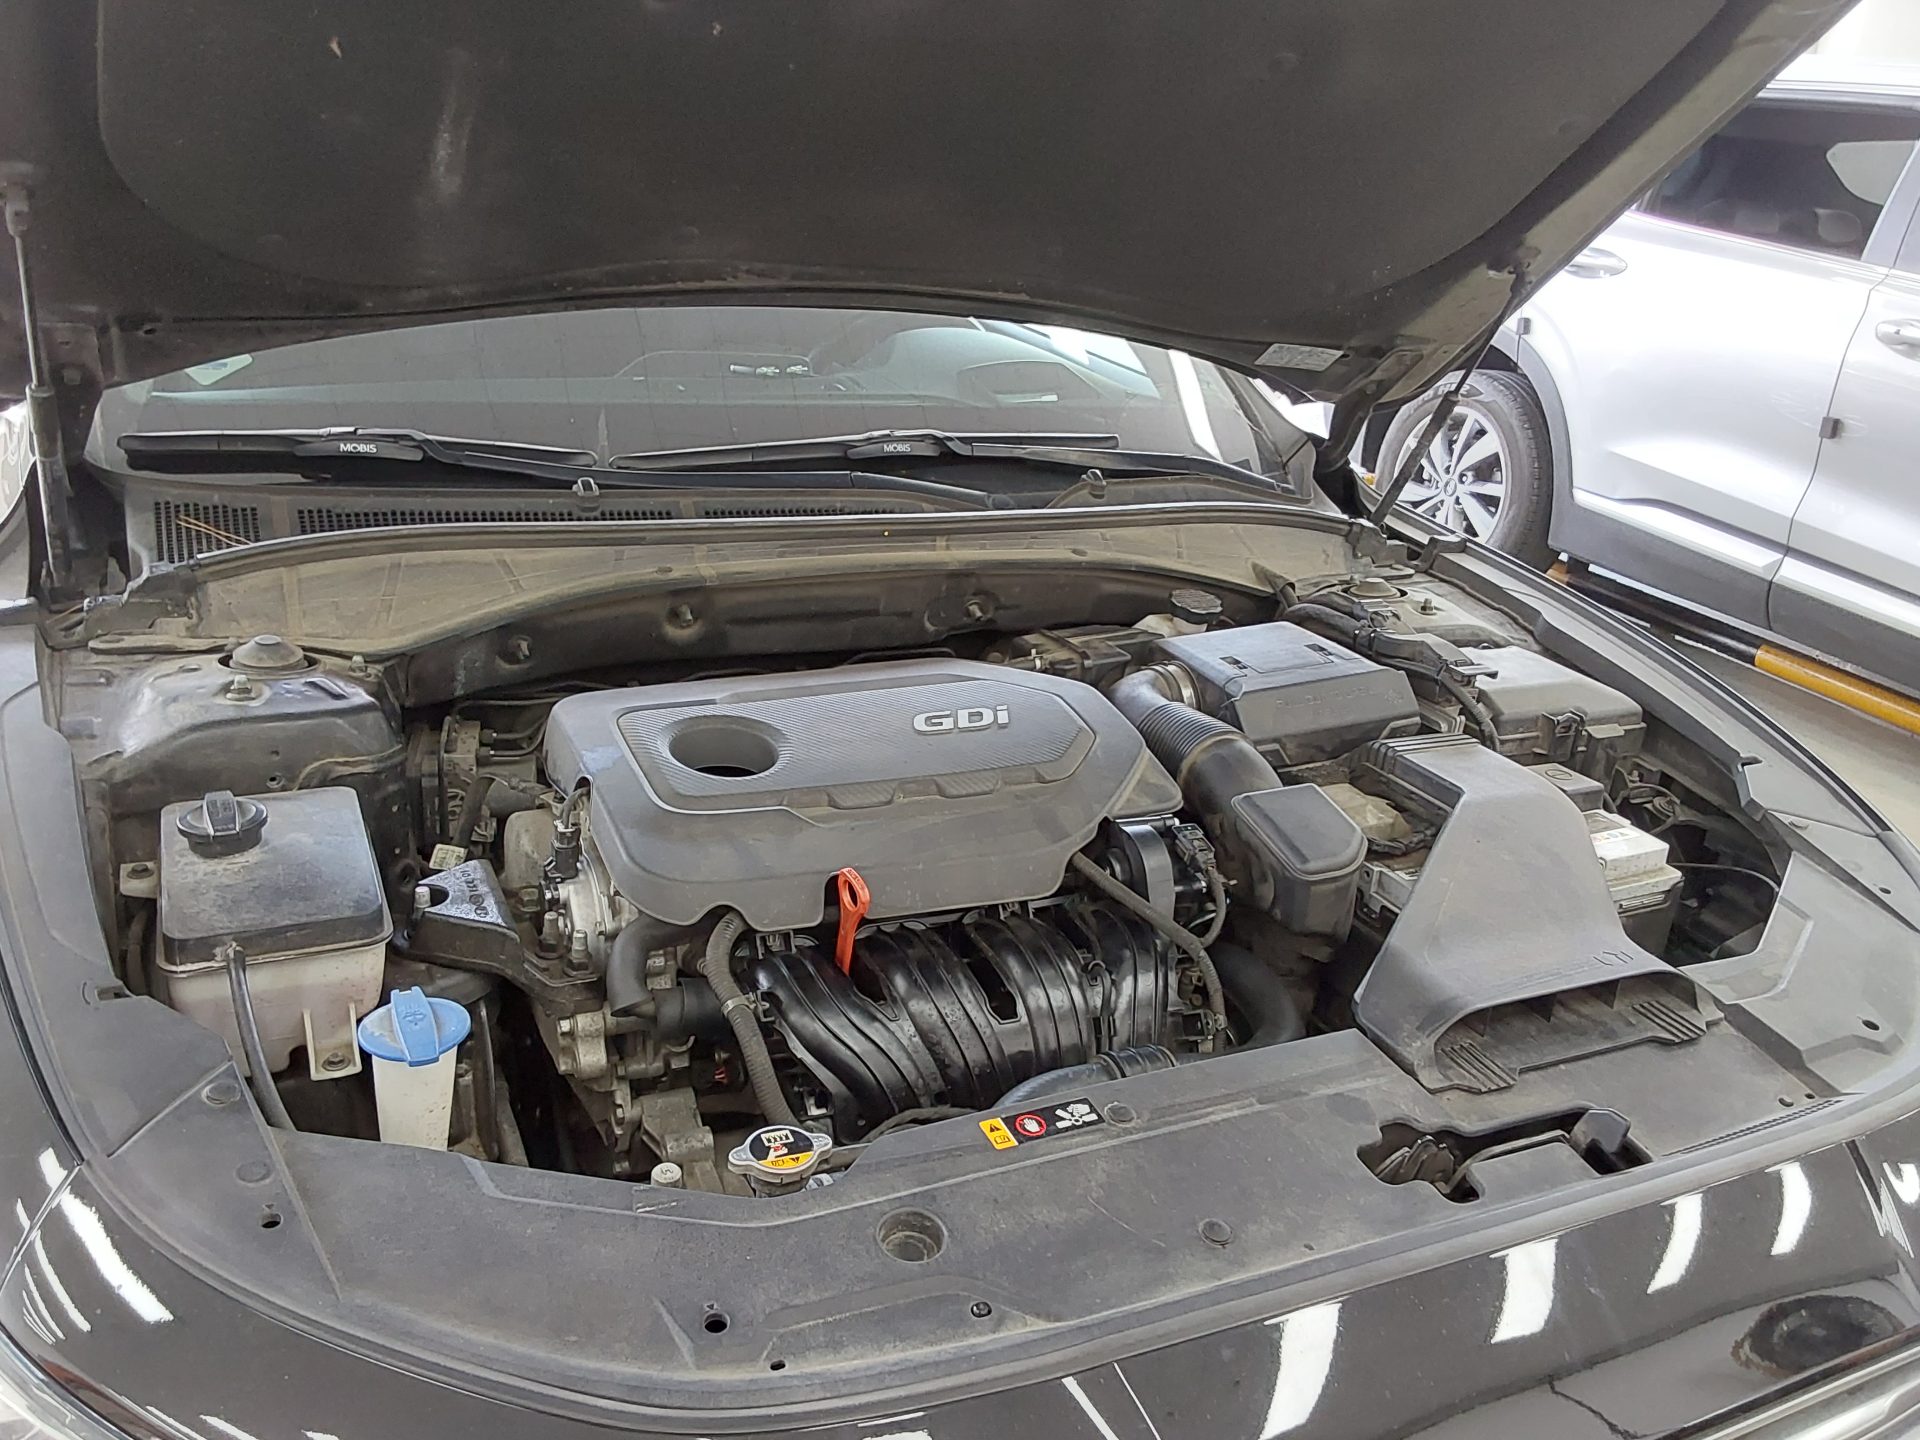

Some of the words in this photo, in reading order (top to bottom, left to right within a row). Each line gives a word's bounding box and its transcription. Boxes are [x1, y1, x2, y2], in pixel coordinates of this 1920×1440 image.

[340, 443, 377, 453] MOBIS
[883, 443, 911, 453] MOBIS
[913, 705, 1009, 733] GDi
